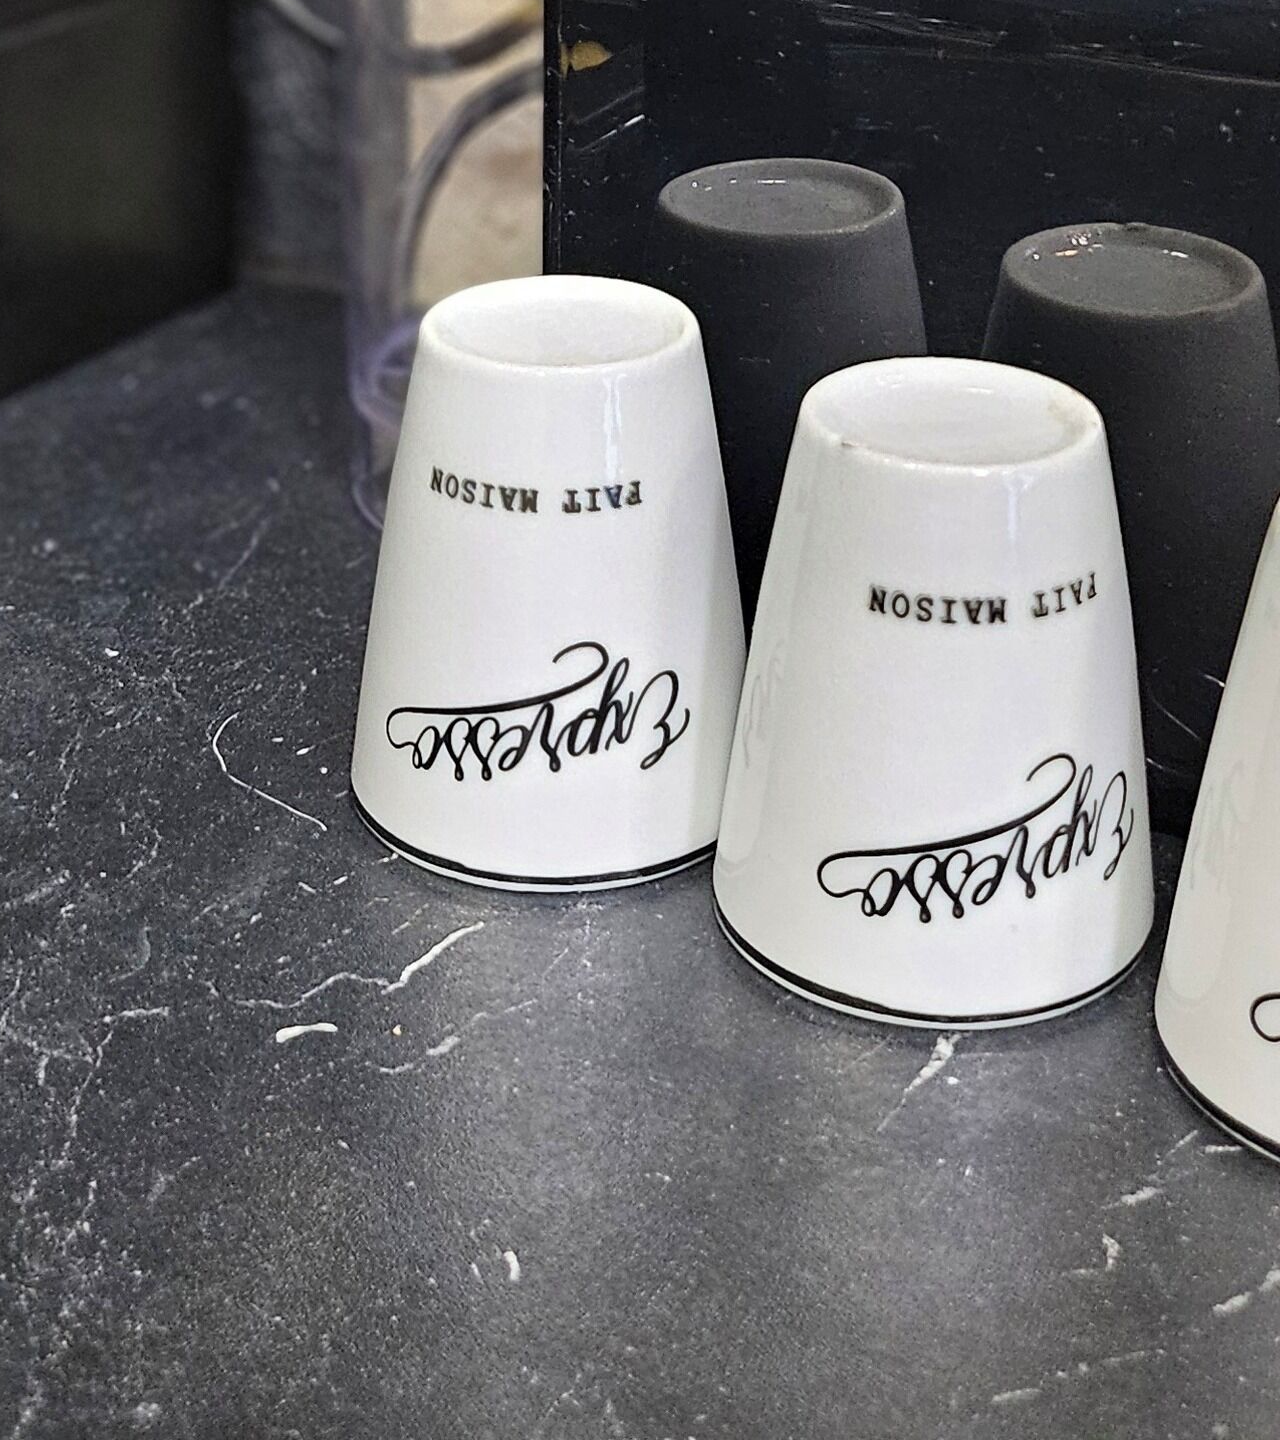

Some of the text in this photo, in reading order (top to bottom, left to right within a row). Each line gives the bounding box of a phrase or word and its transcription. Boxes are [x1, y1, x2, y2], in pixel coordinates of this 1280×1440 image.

[430, 466, 643, 514] FAIT MAISON
[867, 572, 1099, 625] FAIT MAISON
[386, 641, 691, 782] Expresso
[816, 753, 1136, 924] Expresso
